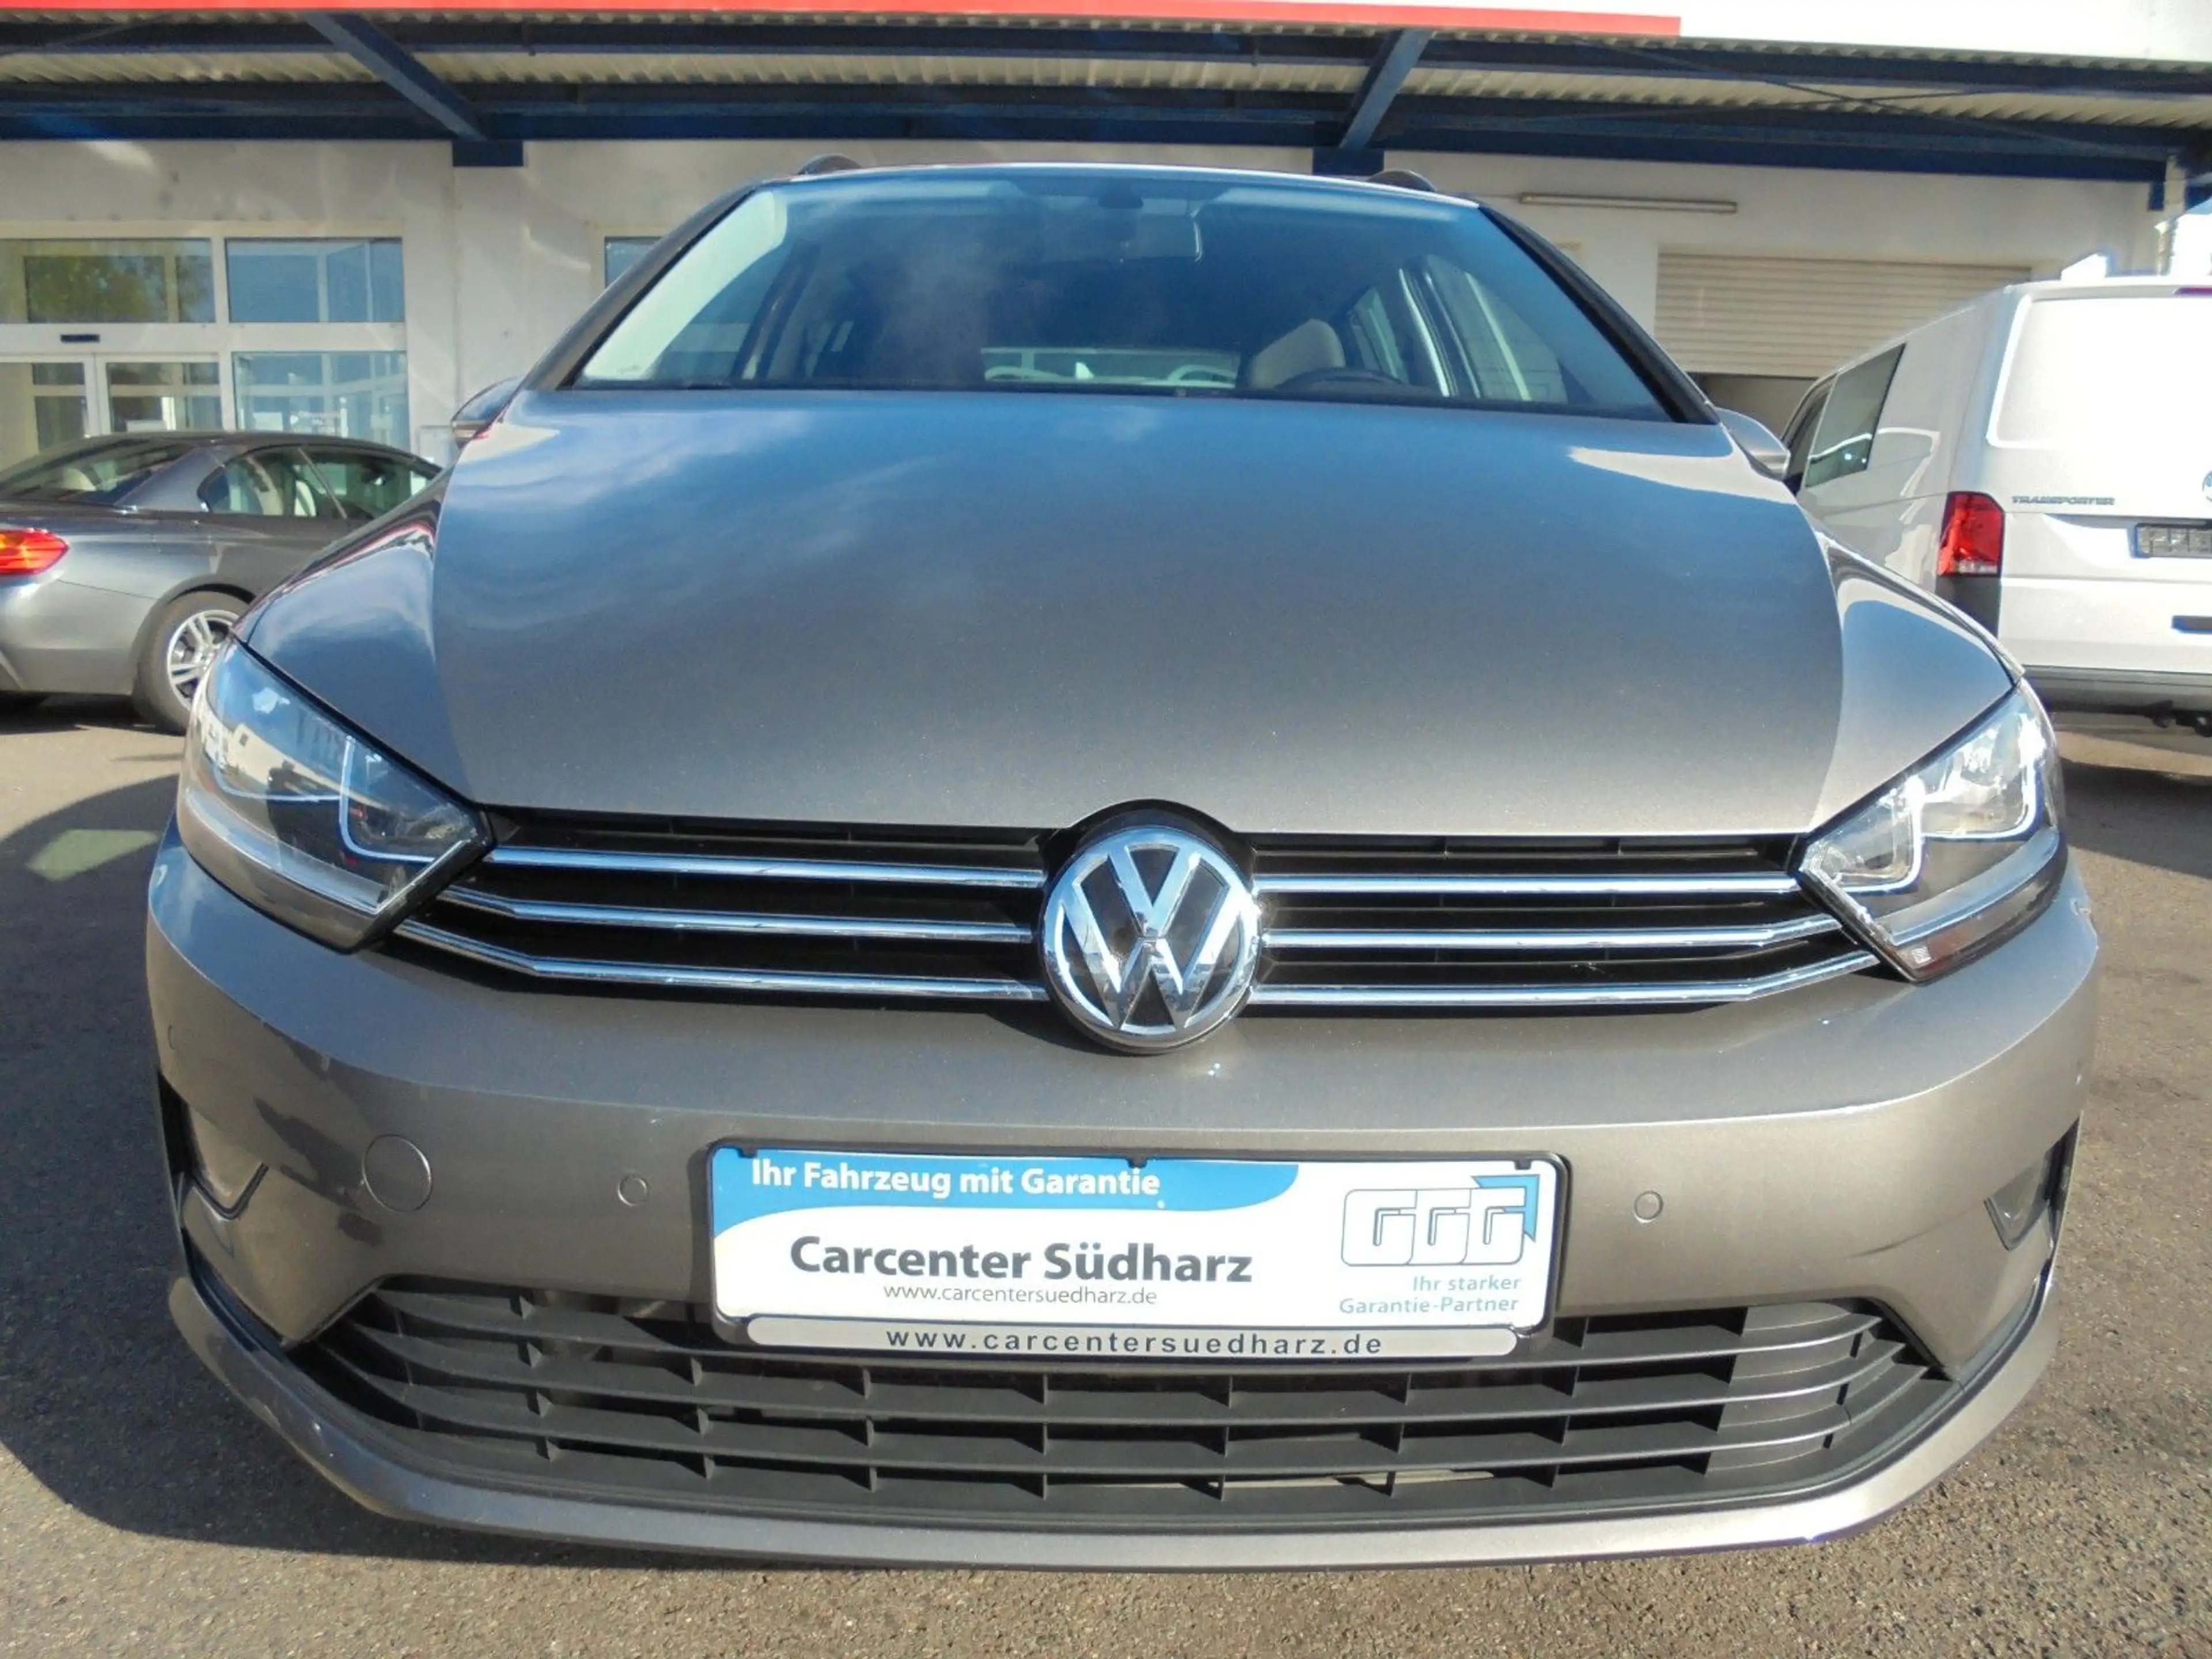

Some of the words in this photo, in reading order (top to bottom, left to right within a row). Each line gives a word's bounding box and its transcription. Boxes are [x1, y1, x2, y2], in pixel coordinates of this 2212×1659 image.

[1055, 836, 1247, 1037] VW
[752, 1157, 797, 1186] Ihr
[804, 1161, 952, 1199] Fahrzeug
[959, 1166, 1014, 1194] mit
[1021, 1166, 1161, 1195] Garantie
[790, 1235, 1032, 1279] Carcenter
[1043, 1241, 1253, 1283] Südharz
[1412, 1275, 1441, 1291] Ihr
[1448, 1274, 1522, 1291] starker
[883, 1285, 1157, 1305] www.carcentersuedharz.de
[1339, 1296, 1520, 1315] Garantie-Partner
[886, 1330, 1382, 1354] www.carcentersuedharz.de
